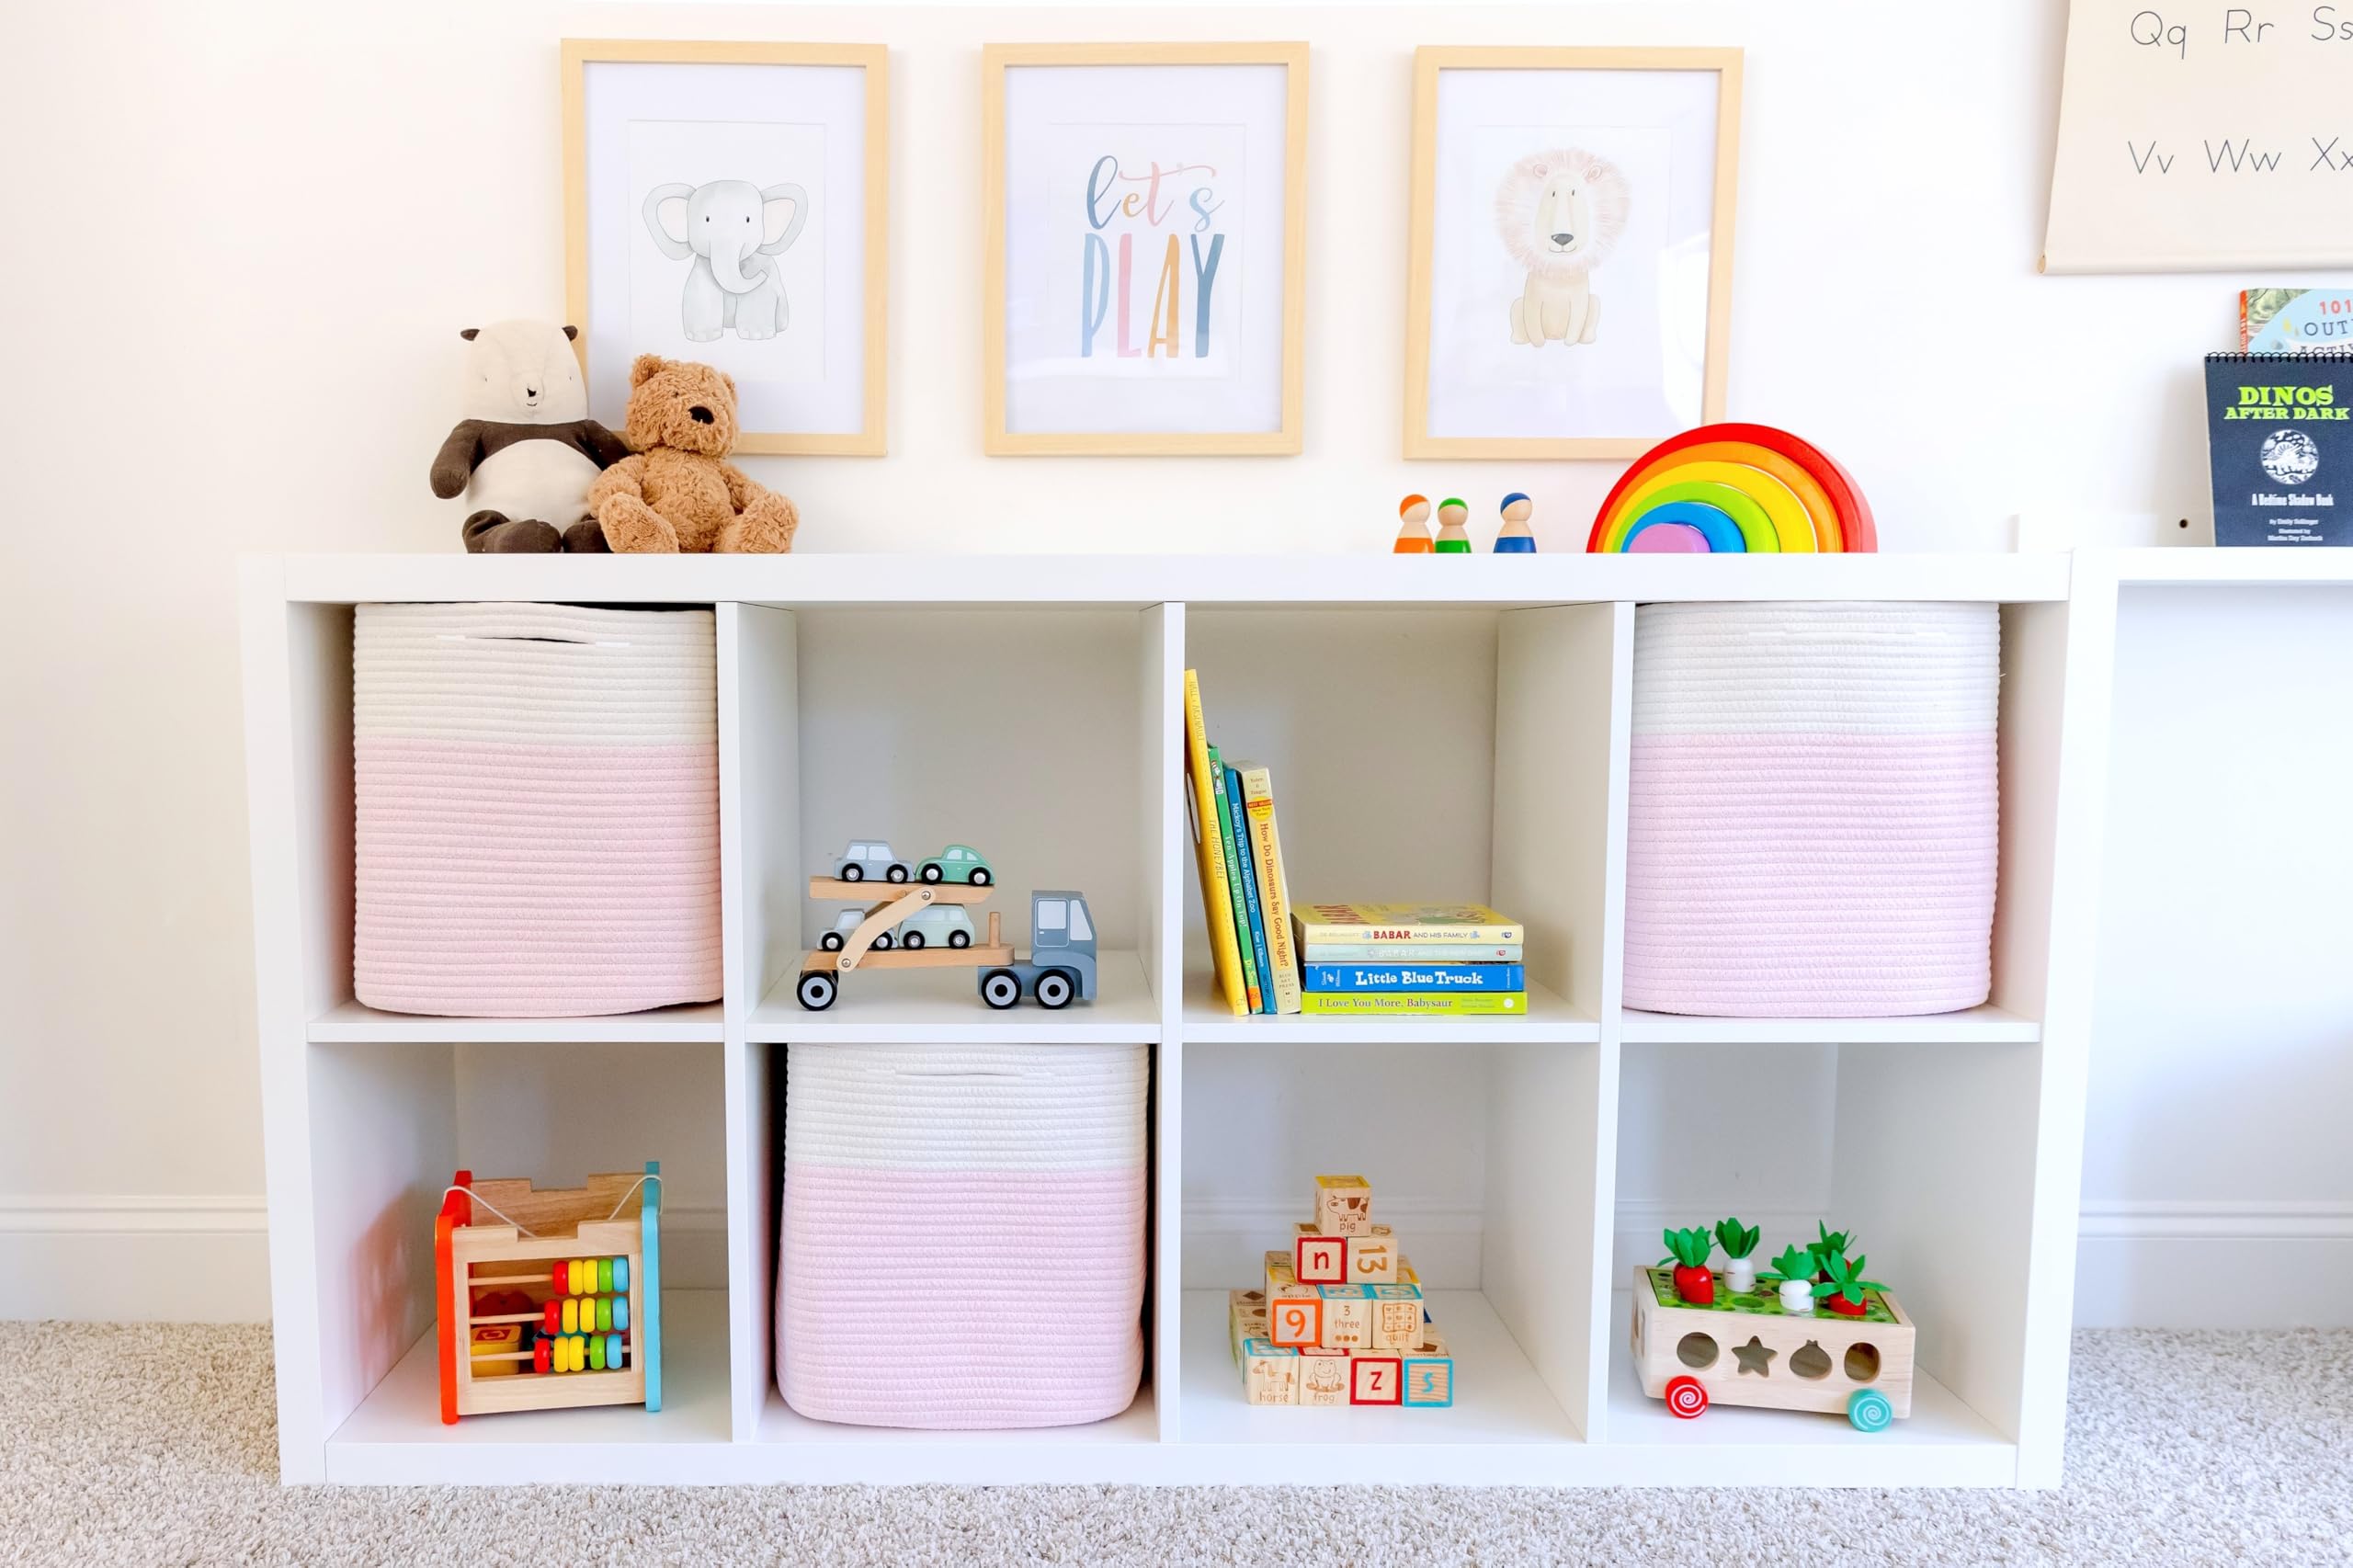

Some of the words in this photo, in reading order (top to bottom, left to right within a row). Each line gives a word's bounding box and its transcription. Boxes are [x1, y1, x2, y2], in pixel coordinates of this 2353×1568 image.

[2131, 11, 2186, 60] Qq
[2225, 9, 2274, 43] Rr
[2128, 141, 2174, 174] Vv
[2204, 139, 2281, 173] Ww
[1086, 155, 1225, 233] let's
[1081, 233, 1225, 358] PLAY
[2319, 300, 2352, 315] 101
[2303, 319, 2353, 336] OUT
[2238, 384, 2335, 407] DINOS
[2223, 407, 2290, 420] AFTER
[2293, 407, 2350, 420] DARK
[1260, 823, 1268, 842] How
[1240, 848, 1246, 857] to
[1263, 845, 1271, 857] Do
[1265, 859, 1277, 899] Dinosaurs
[1271, 900, 1280, 915] Say
[1274, 916, 1284, 939] Good
[1372, 930, 1411, 939] BABAR
[1277, 940, 1289, 967] Night?
[1355, 971, 1398, 986] Little
[1402, 971, 1434, 985] Blue
[1435, 971, 1483, 985] Truck
[1318, 999, 1323, 1007] I
[1325, 999, 1349, 1007] Love
[1352, 999, 1371, 1007] You
[1407, 998, 1453, 1010] Babysaur
[1339, 1221, 1357, 1233] pig
[1357, 1244, 1387, 1274] 13
[1344, 1305, 1351, 1316] 3
[1286, 1309, 1306, 1338] 9
[1334, 1319, 1360, 1329] three
[1386, 1334, 1409, 1345] quilt
[1259, 1392, 1289, 1403] horse
[1313, 1392, 1336, 1404] frog
